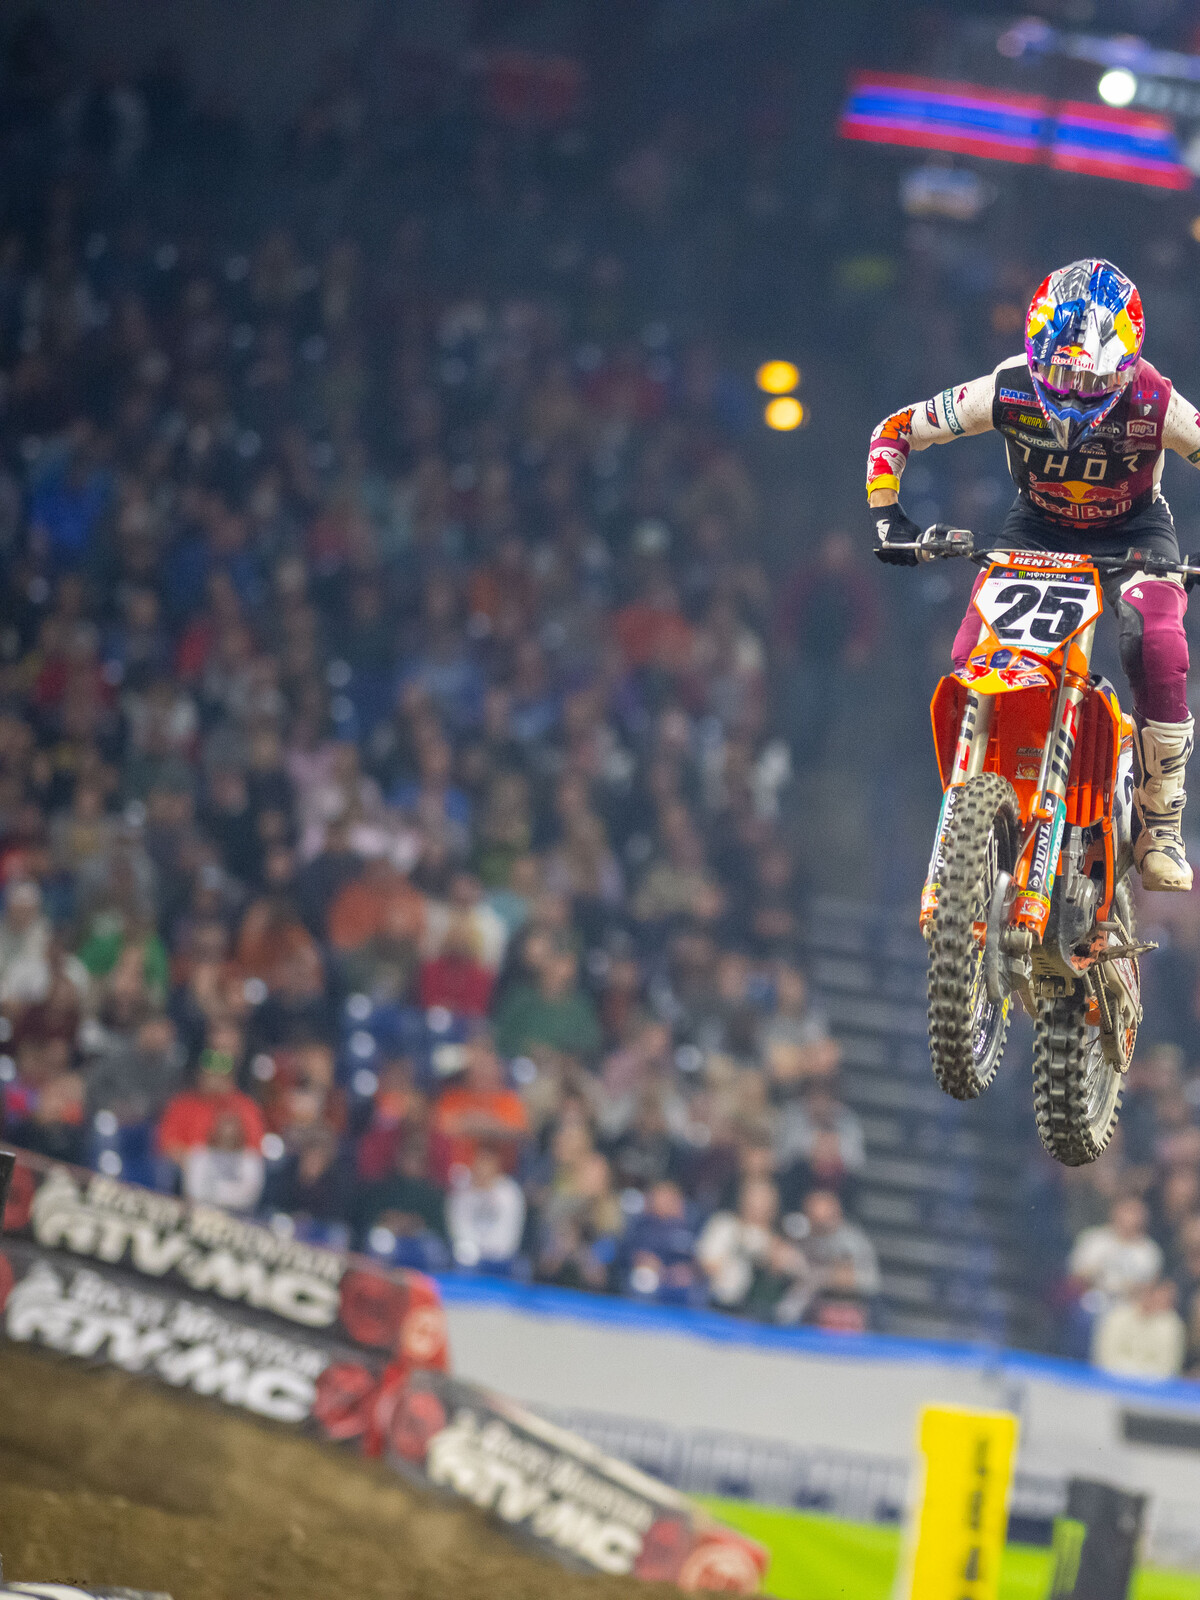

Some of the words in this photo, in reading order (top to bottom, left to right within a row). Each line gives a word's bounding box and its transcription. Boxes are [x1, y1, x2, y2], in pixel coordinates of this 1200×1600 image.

[1051, 355, 1073, 365] Red
[1074, 358, 1095, 370] Bull
[943, 389, 961, 434] MOTOREX
[1018, 432, 1062, 449] MOTOREX
[1131, 424, 1153, 434] 100%
[1030, 490, 1079, 519] Red
[1081, 499, 1132, 519] Bull
[1026, 571, 1067, 580] MONSTER
[994, 584, 1091, 642] 25
[1033, 798, 1053, 875] DUNLP
[1050, 816, 1065, 875] MOTOREX
